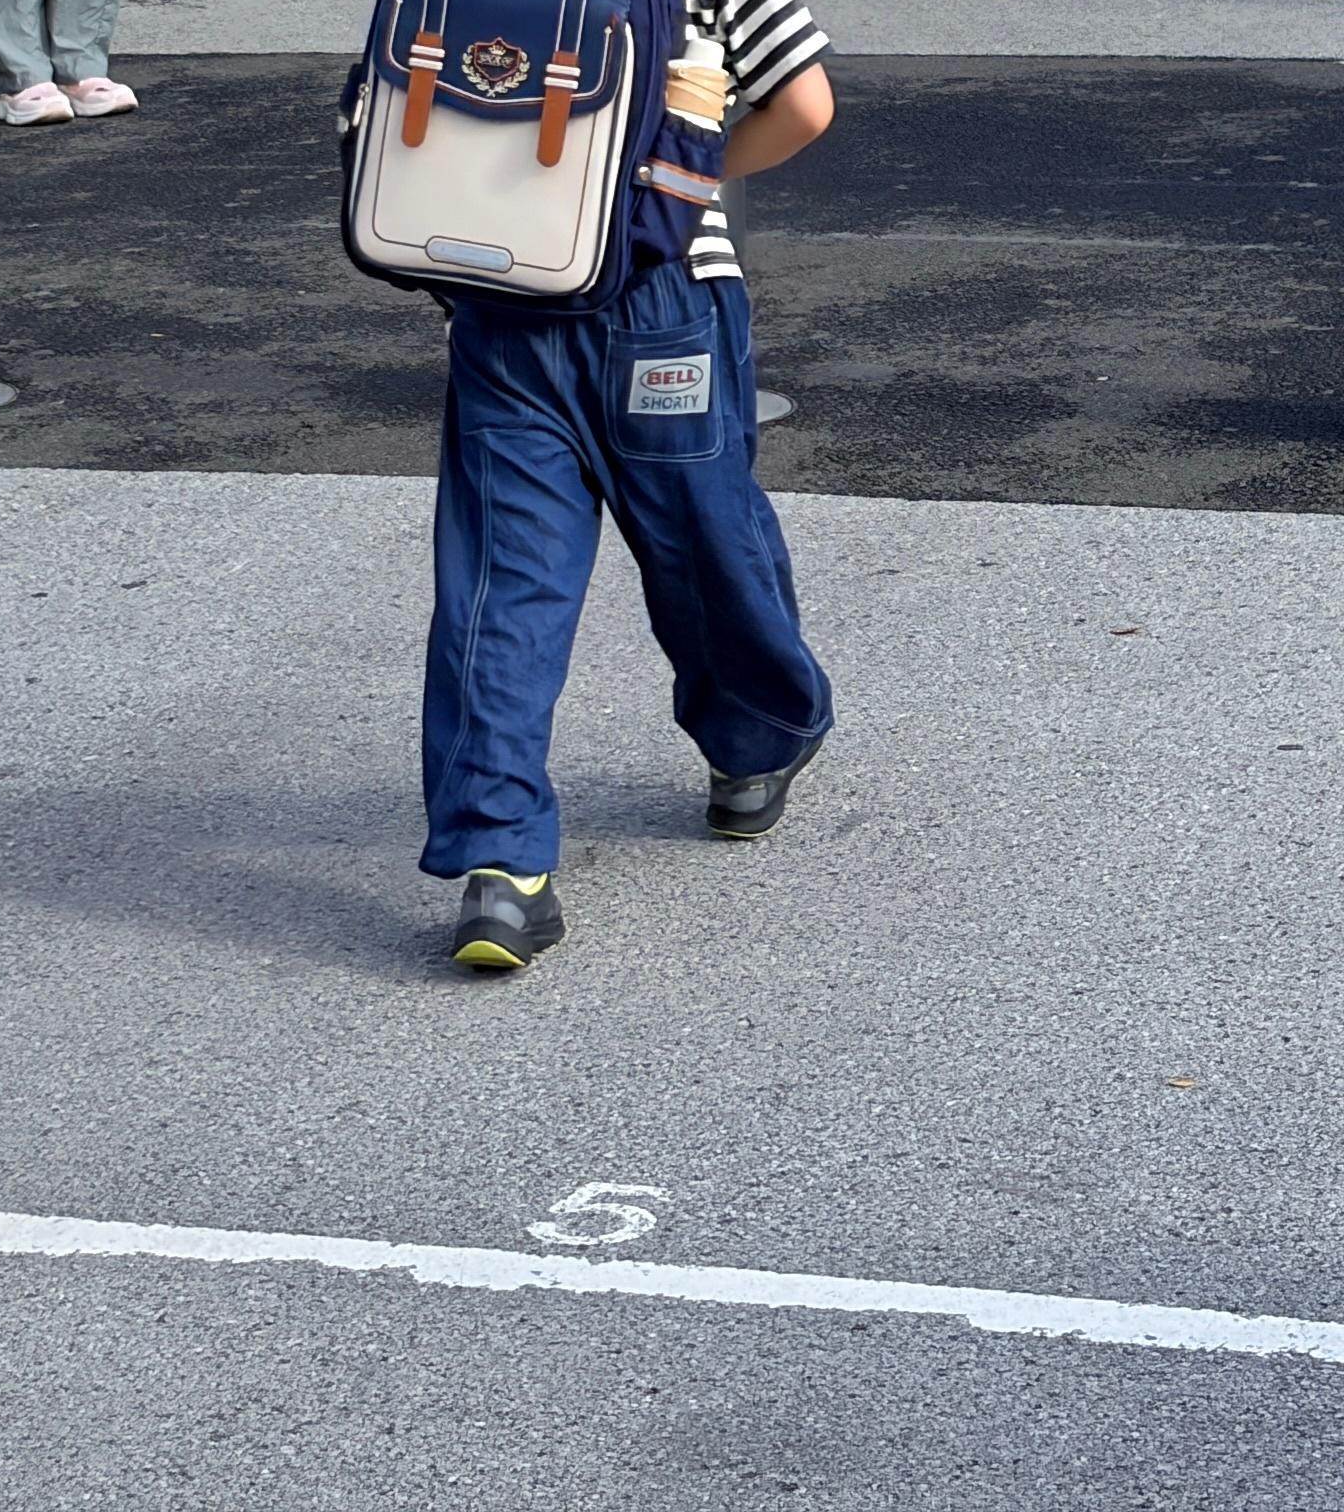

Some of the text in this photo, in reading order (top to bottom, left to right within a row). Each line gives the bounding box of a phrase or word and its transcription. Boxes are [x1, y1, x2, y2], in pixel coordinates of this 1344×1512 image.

[646, 368, 697, 386] BELL
[640, 394, 699, 410] SHORTY
[525, 1181, 674, 1246] 5
